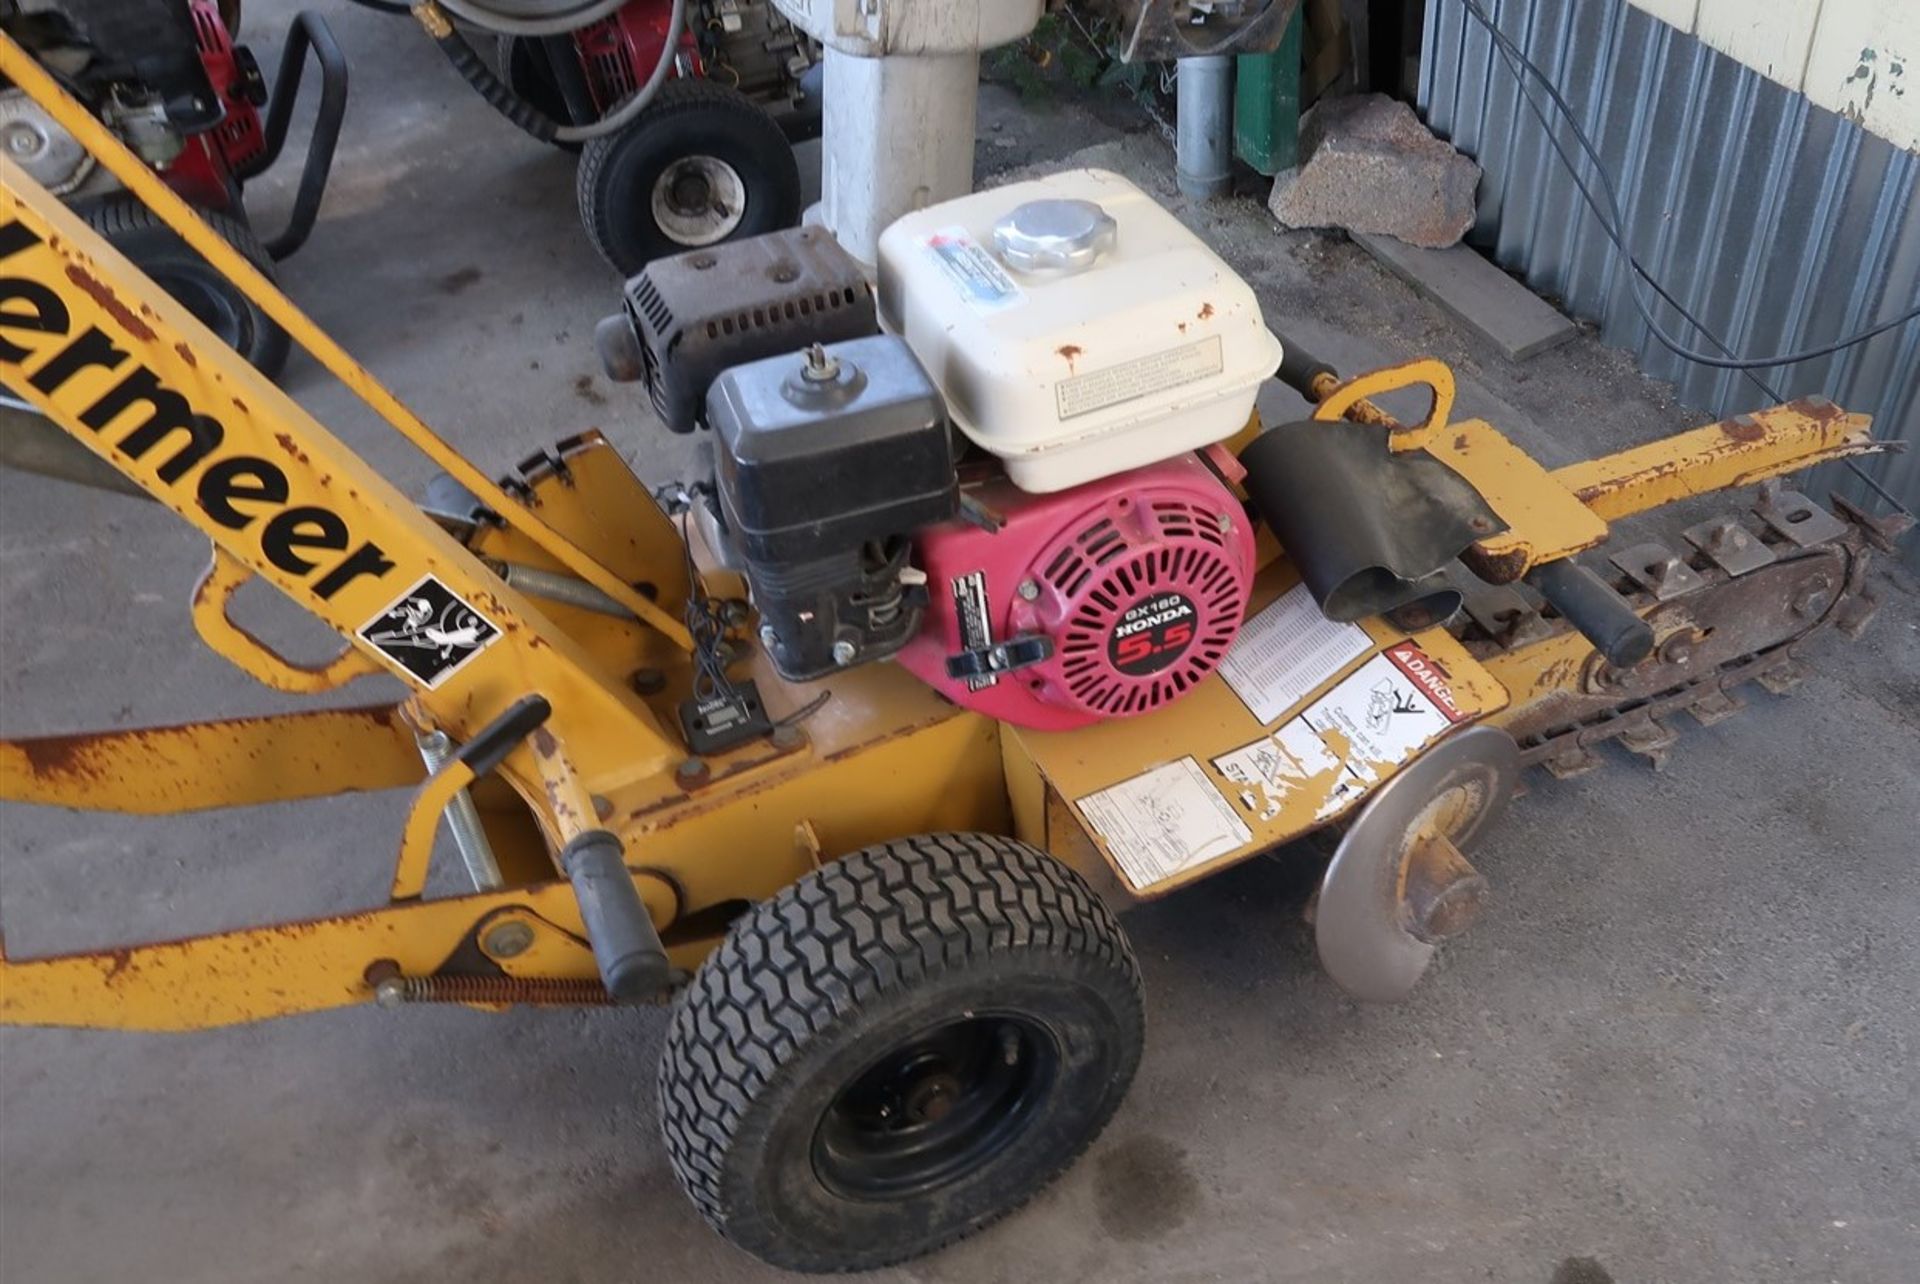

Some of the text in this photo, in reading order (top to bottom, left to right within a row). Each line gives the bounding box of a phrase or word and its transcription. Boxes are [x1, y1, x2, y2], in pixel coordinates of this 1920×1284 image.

[0, 219, 396, 600] ermeer
[1116, 605, 1192, 638] HONDA
[1117, 622, 1191, 665] 5.5
[1407, 660, 1463, 717] DANGE
